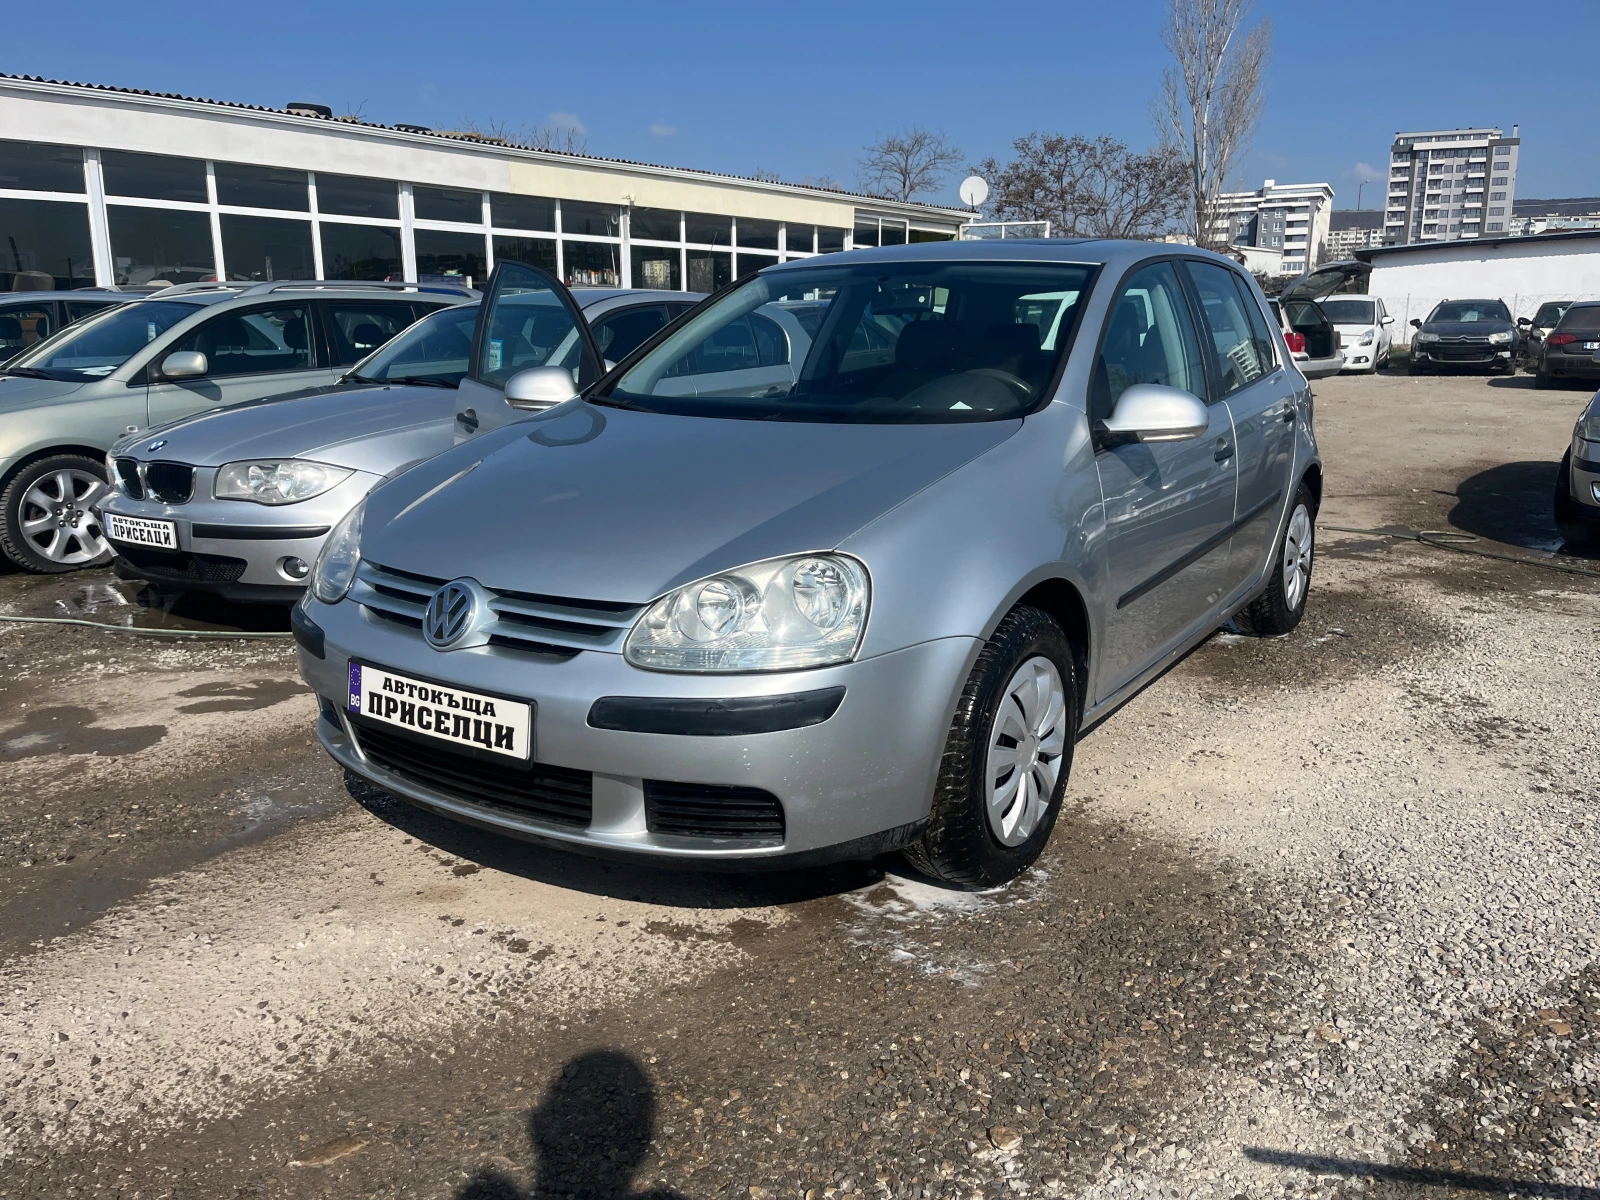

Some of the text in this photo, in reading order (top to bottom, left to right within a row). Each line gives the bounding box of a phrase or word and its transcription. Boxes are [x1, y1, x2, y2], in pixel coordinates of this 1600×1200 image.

[112, 516, 169, 530] АВТОКЪЩА
[113, 524, 171, 545] ПРИСЕЛЦИ
[424, 583, 472, 642] VW
[350, 693, 360, 707] BG
[382, 677, 496, 717] АВТОКЪЩА
[368, 691, 515, 750] ПРИСЕЛЦИ
